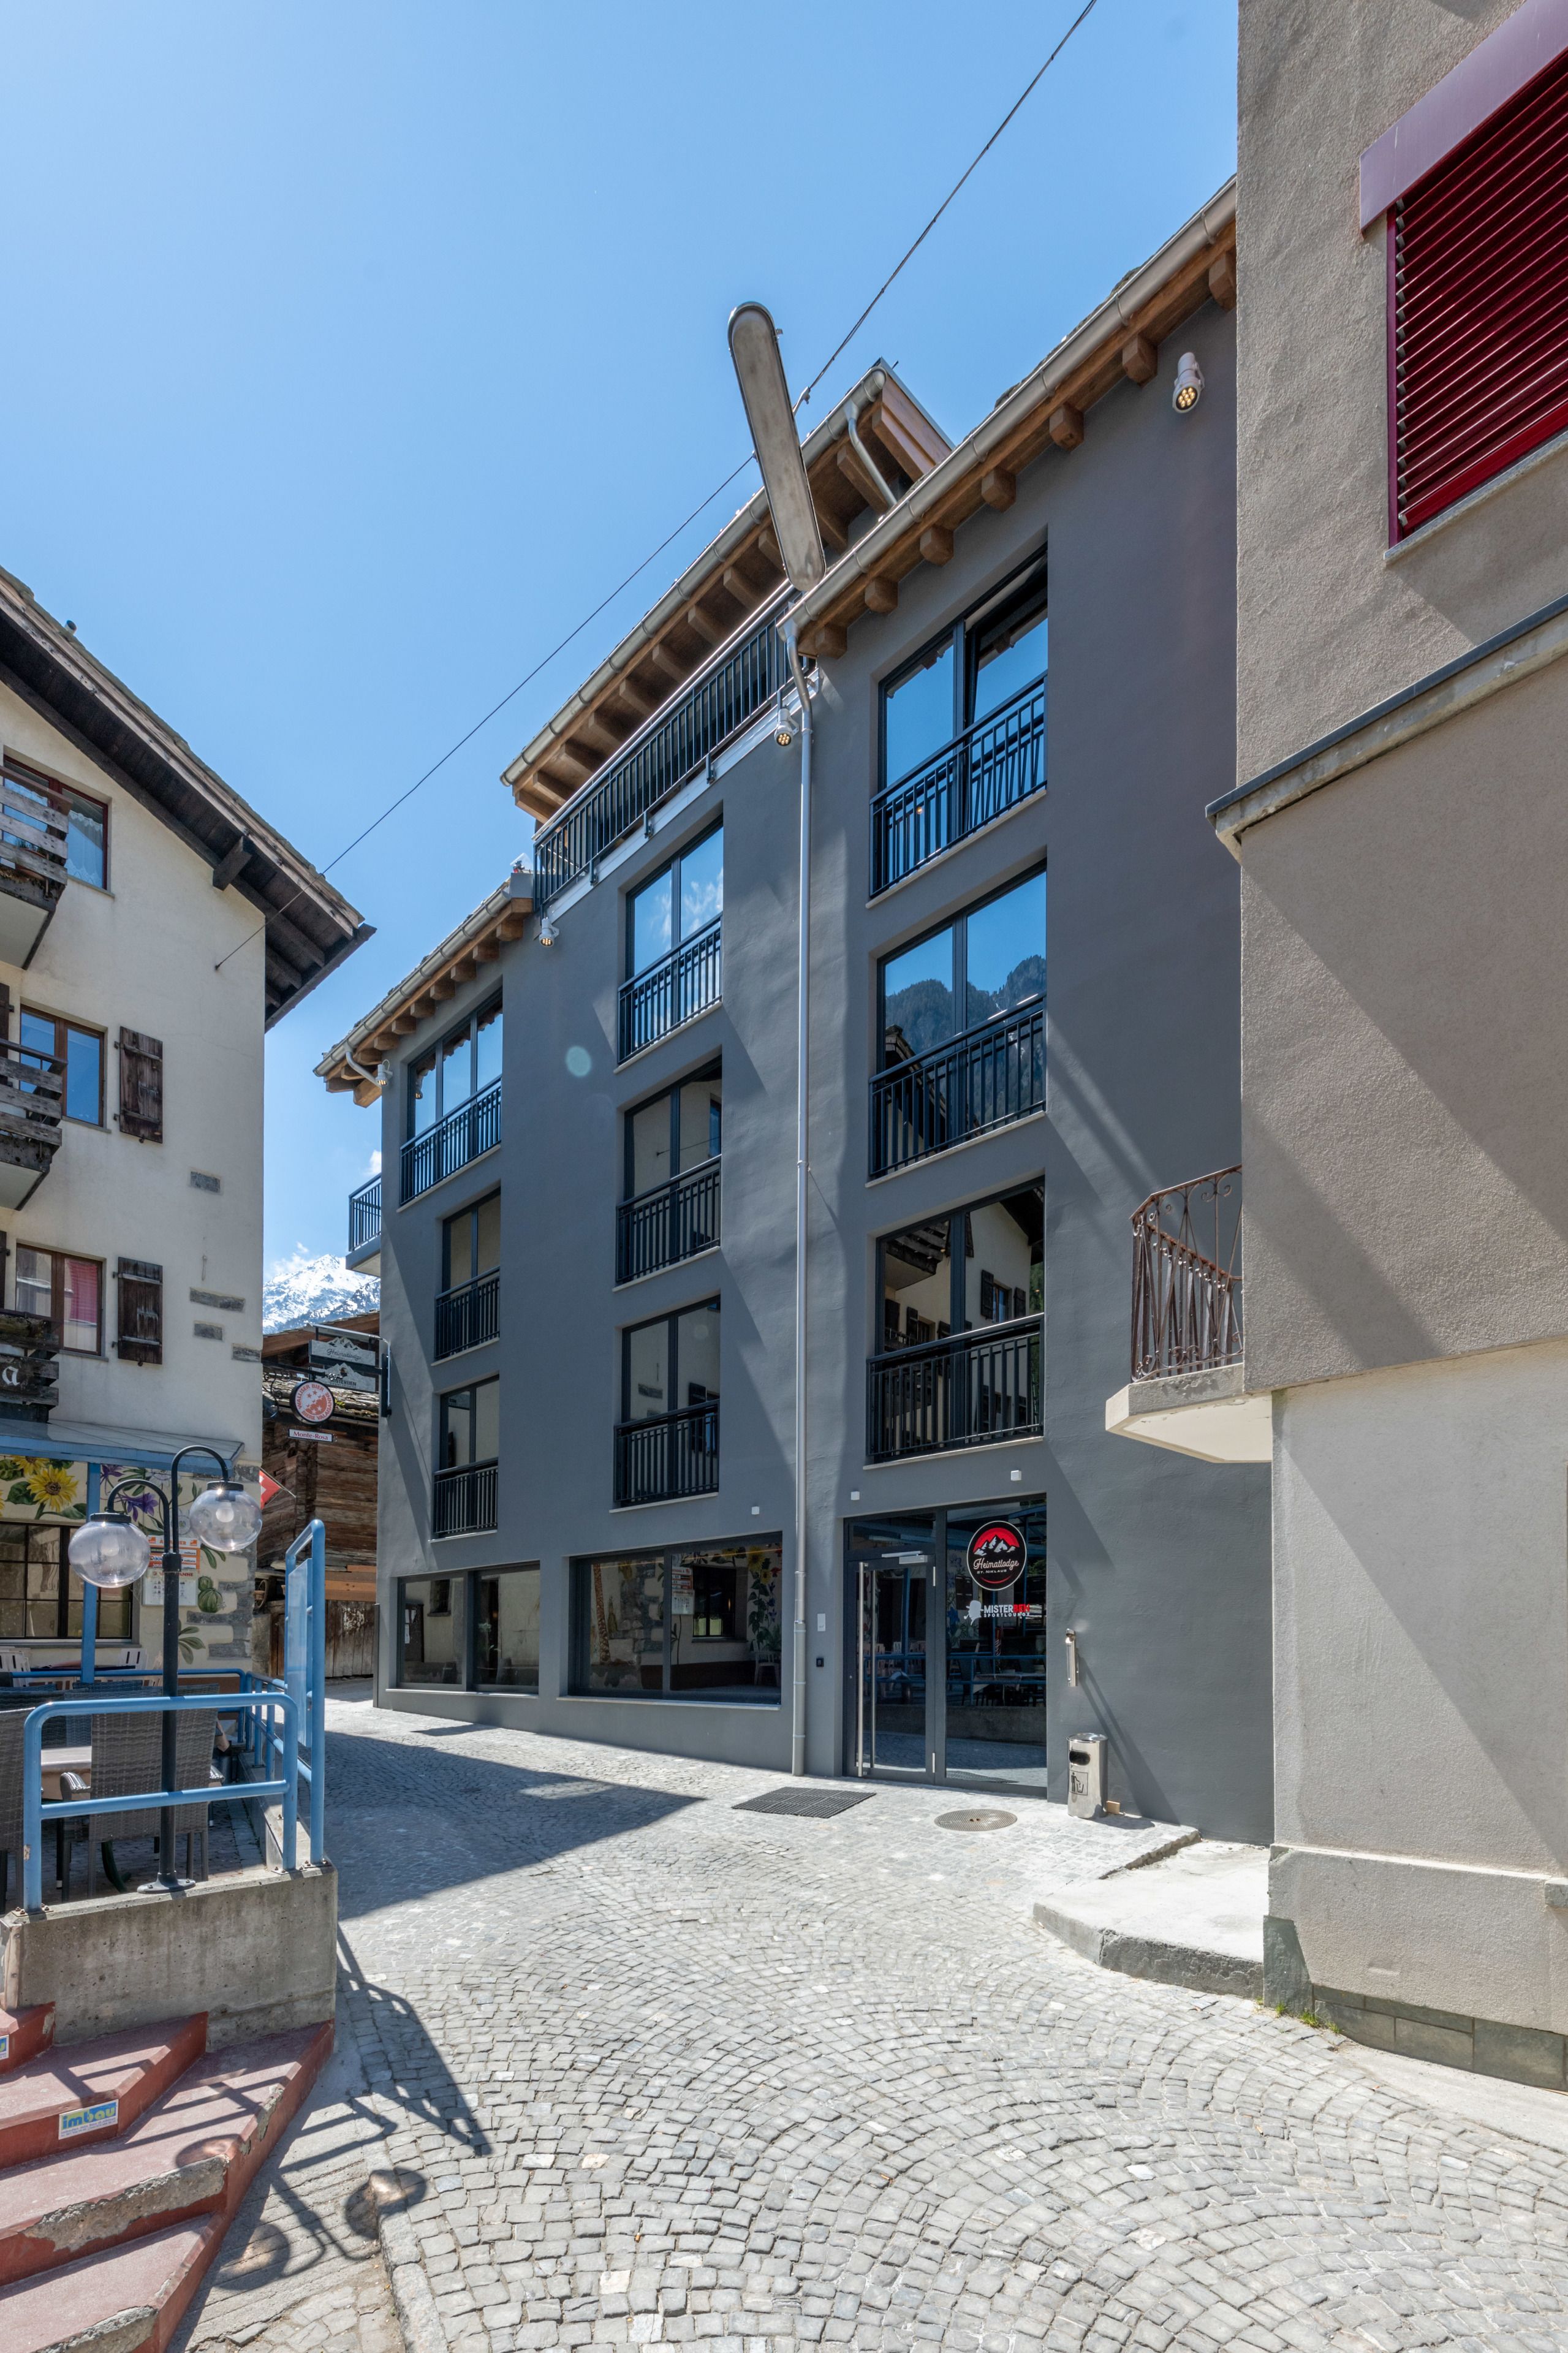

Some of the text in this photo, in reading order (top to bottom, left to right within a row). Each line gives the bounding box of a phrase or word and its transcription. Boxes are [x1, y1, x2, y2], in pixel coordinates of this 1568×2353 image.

[297, 1384, 311, 1409] WALLISER
[294, 1431, 328, 1441] Monte-Rosa
[973, 1558, 1020, 1571] Heimatlodge
[62, 2107, 115, 2129] imbau
